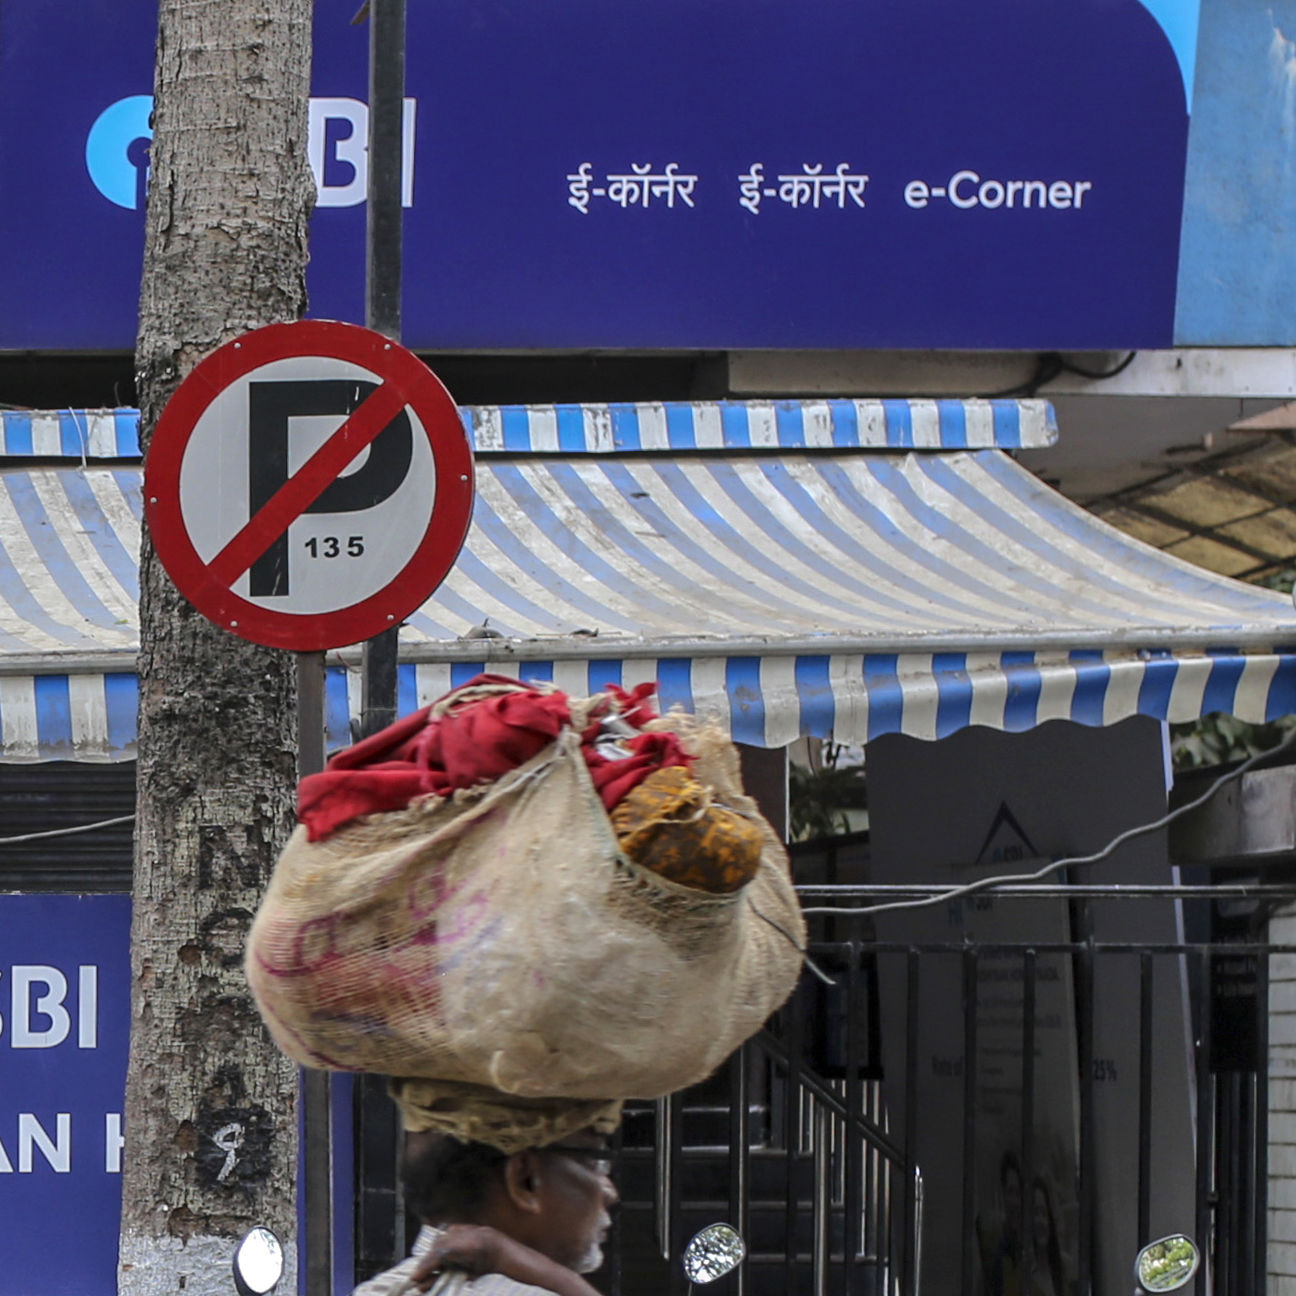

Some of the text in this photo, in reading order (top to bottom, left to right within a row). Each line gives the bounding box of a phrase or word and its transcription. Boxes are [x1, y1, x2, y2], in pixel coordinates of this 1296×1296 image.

[904, 170, 1092, 209] e-Corner
[249, 379, 414, 597] P
[304, 536, 365, 558] 135
